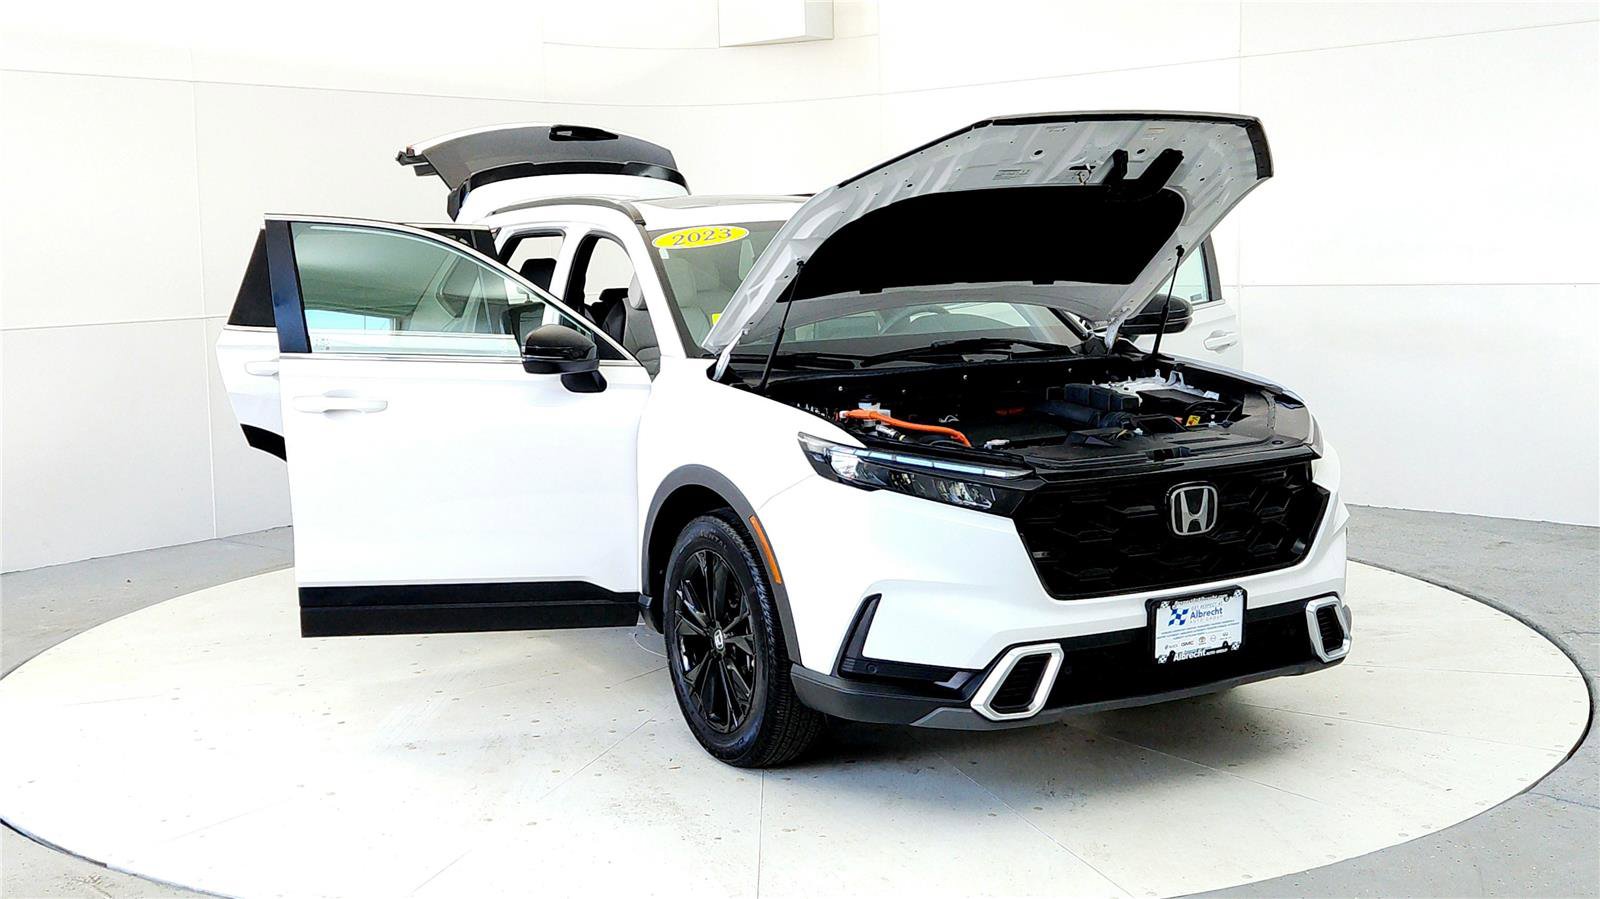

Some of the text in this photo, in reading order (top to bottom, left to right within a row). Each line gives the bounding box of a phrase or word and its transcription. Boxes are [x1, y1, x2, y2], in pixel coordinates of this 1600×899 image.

[672, 228, 732, 246] 2023
[1190, 607, 1223, 619] Albrecht
[1173, 648, 1206, 662] Albrecht
